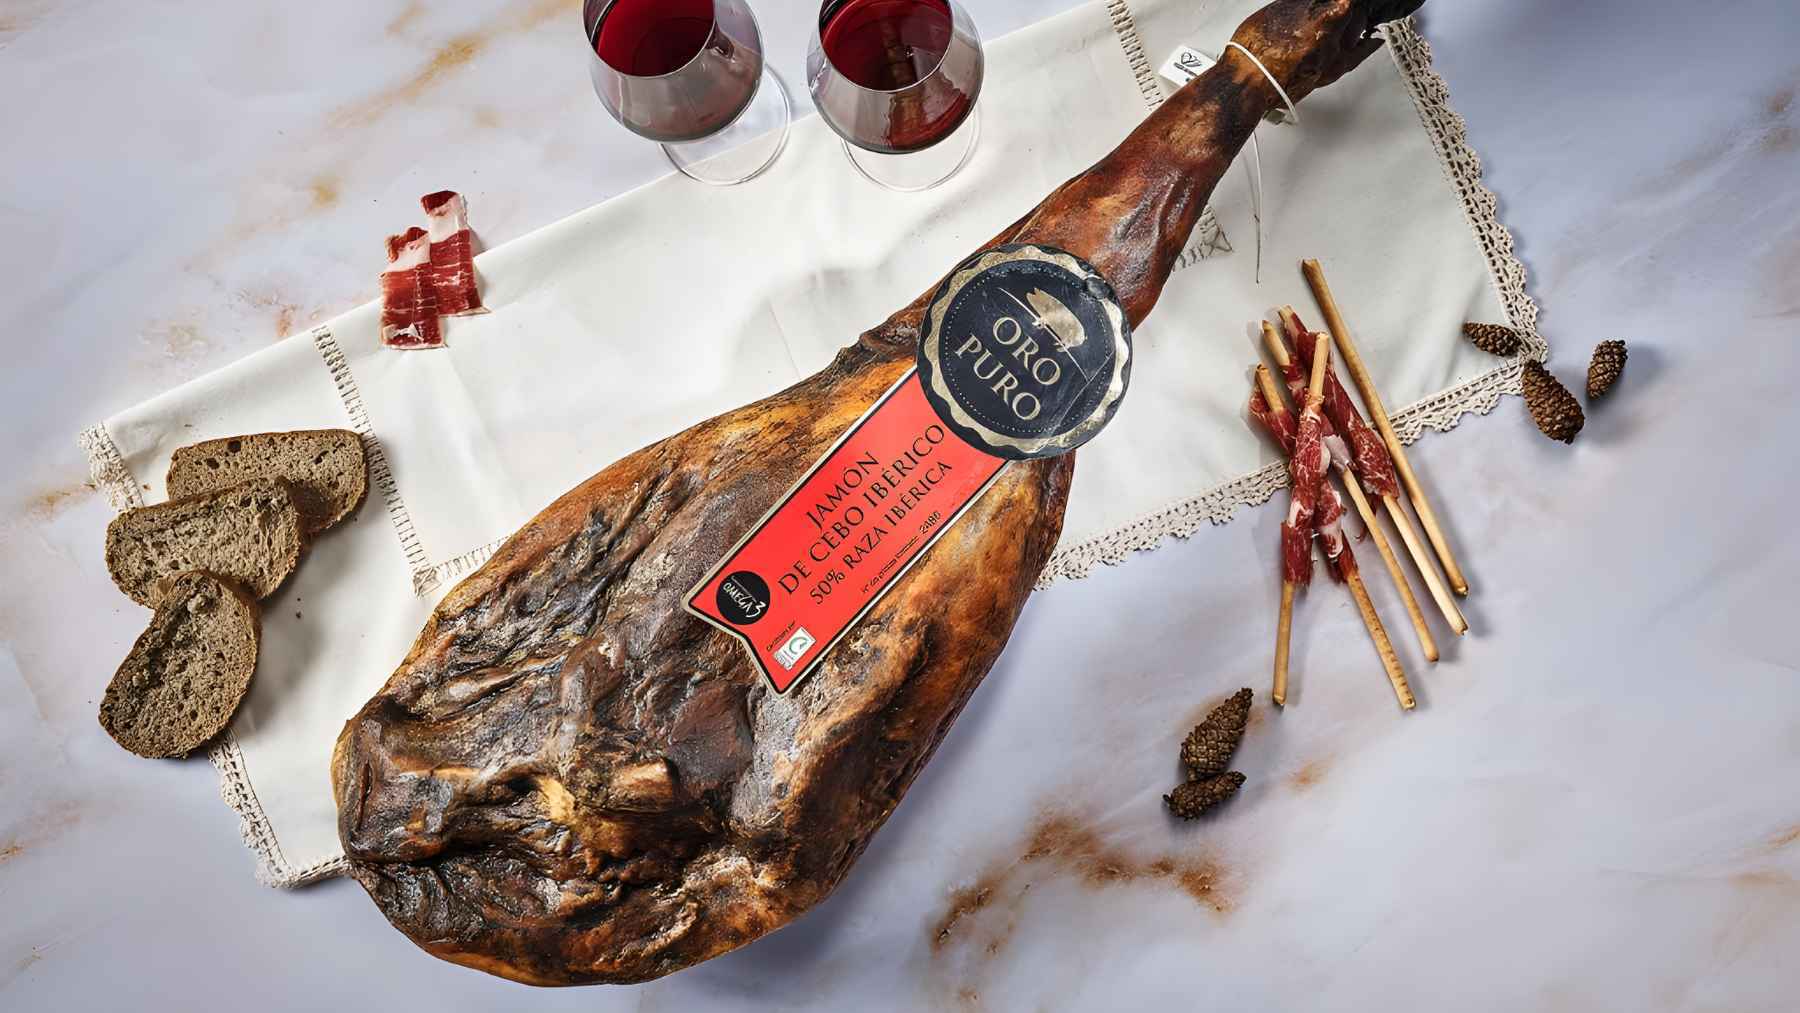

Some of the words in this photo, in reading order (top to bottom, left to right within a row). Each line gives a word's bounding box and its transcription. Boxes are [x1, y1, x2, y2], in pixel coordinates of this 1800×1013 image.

[955, 333, 1041, 420] PURO
[993, 317, 1061, 385] ORO
[778, 560, 811, 594] DE
[809, 506, 864, 562] CEBO
[863, 425, 945, 507] IBÉRICO
[806, 451, 880, 529] JAMÓN
[809, 568, 846, 605] 50%
[842, 526, 888, 570] RAZA
[884, 461, 953, 527] IBÉRICA
